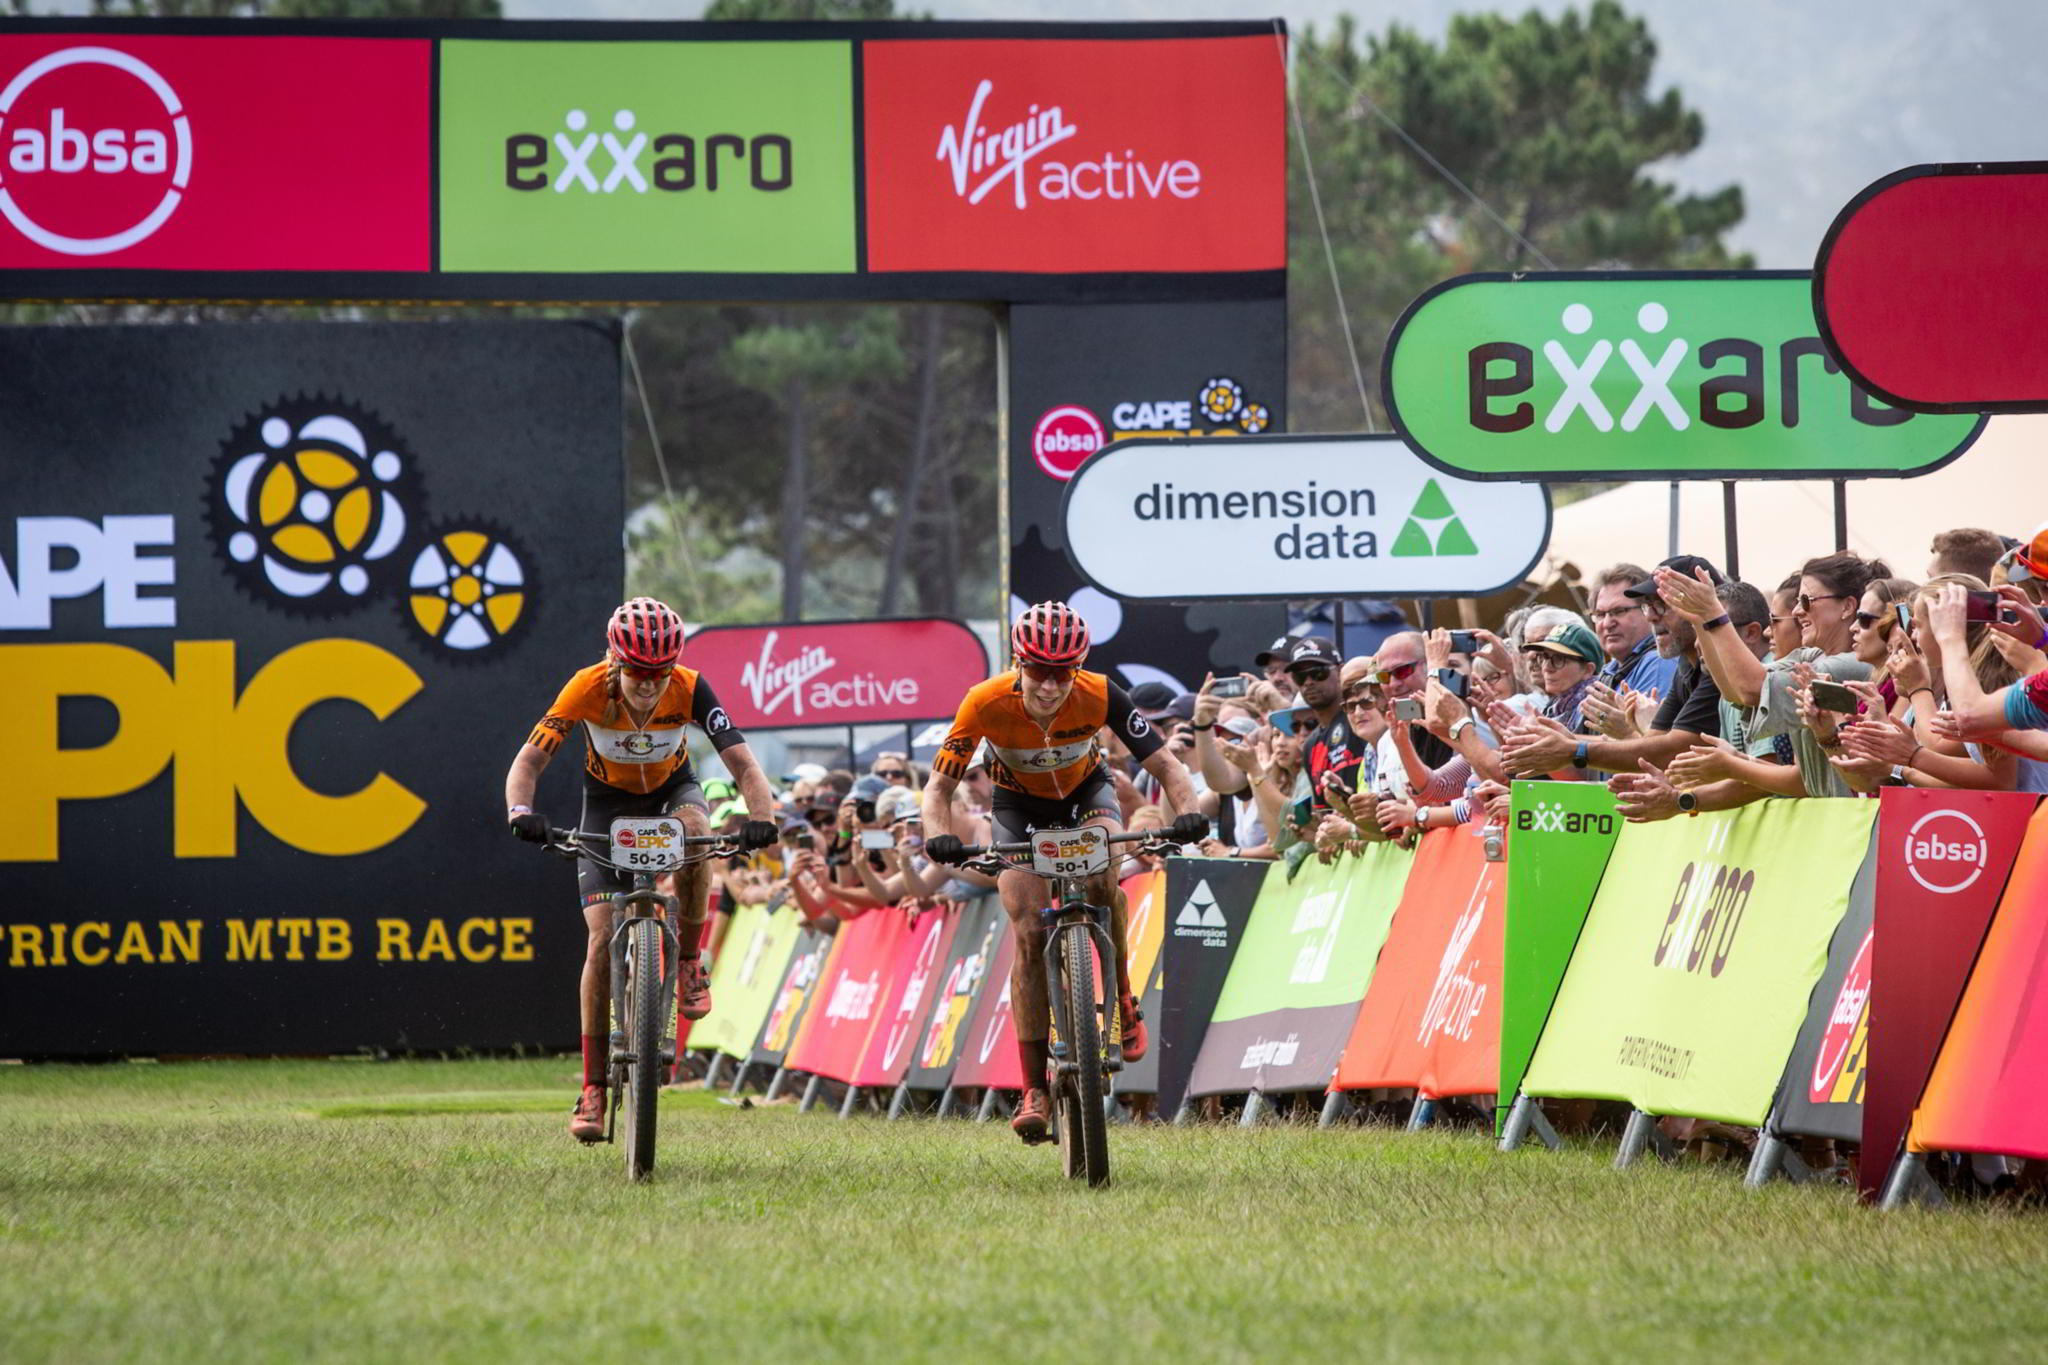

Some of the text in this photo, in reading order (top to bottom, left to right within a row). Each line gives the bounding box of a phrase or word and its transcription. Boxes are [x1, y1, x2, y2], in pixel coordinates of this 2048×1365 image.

[9, 108, 167, 173] absa
[505, 109, 793, 193] exxaro
[937, 80, 1076, 209] Virgin
[1038, 150, 1200, 199] active
[1113, 401, 1191, 429] CAPE
[1043, 427, 1094, 453] absa
[1134, 480, 1376, 521] dimension
[1274, 524, 1378, 560] data
[0, 514, 177, 629] PE
[740, 631, 836, 716] Virgin
[809, 672, 919, 709] active
[1516, 801, 1613, 835] exxaro
[630, 853, 666, 865] 50-2
[637, 836, 672, 848] EPIC
[1060, 843, 1096, 858] EPIC
[1914, 834, 1977, 861] absa
[1056, 860, 1089, 872] 50-1
[1653, 821, 1755, 978] exxaro
[0, 918, 534, 967] RICAN MTB RACE
[1174, 927, 1227, 938] dimension
[1202, 938, 1227, 947] data
